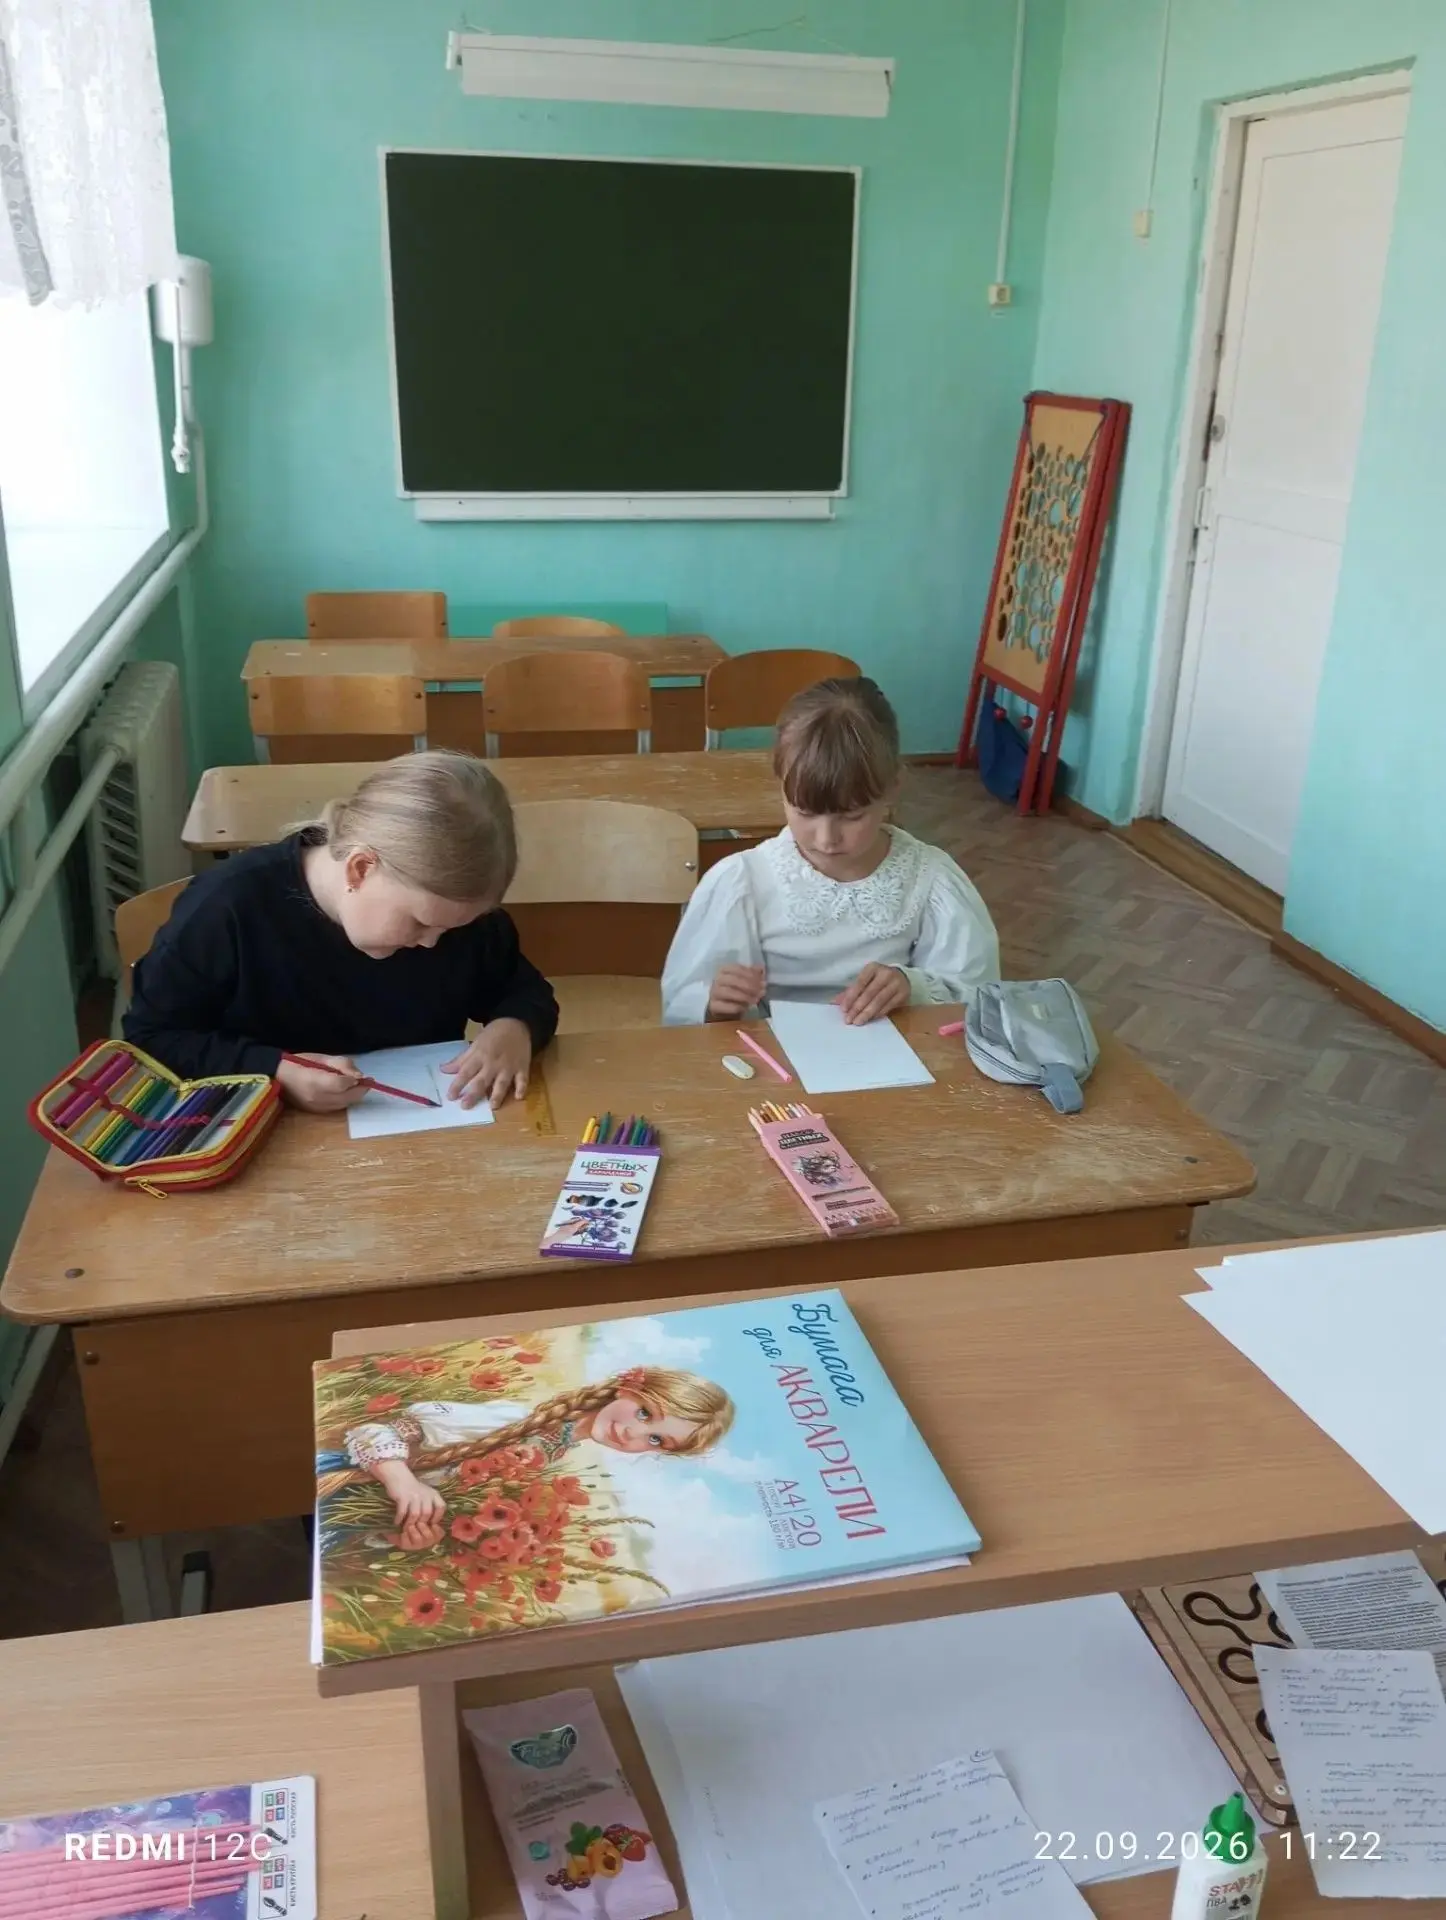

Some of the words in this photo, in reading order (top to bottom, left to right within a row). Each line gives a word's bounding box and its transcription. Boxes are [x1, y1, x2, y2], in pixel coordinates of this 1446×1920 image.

[580, 1160, 648, 1173] ЦВЕТНЫХ
[788, 1303, 865, 1407] Бумага
[742, 1327, 783, 1360] для
[769, 1363, 887, 1540] АКВАРЕЛИ
[788, 1514, 822, 1547] 20
[1206, 1896, 1227, 1908] ПВА
